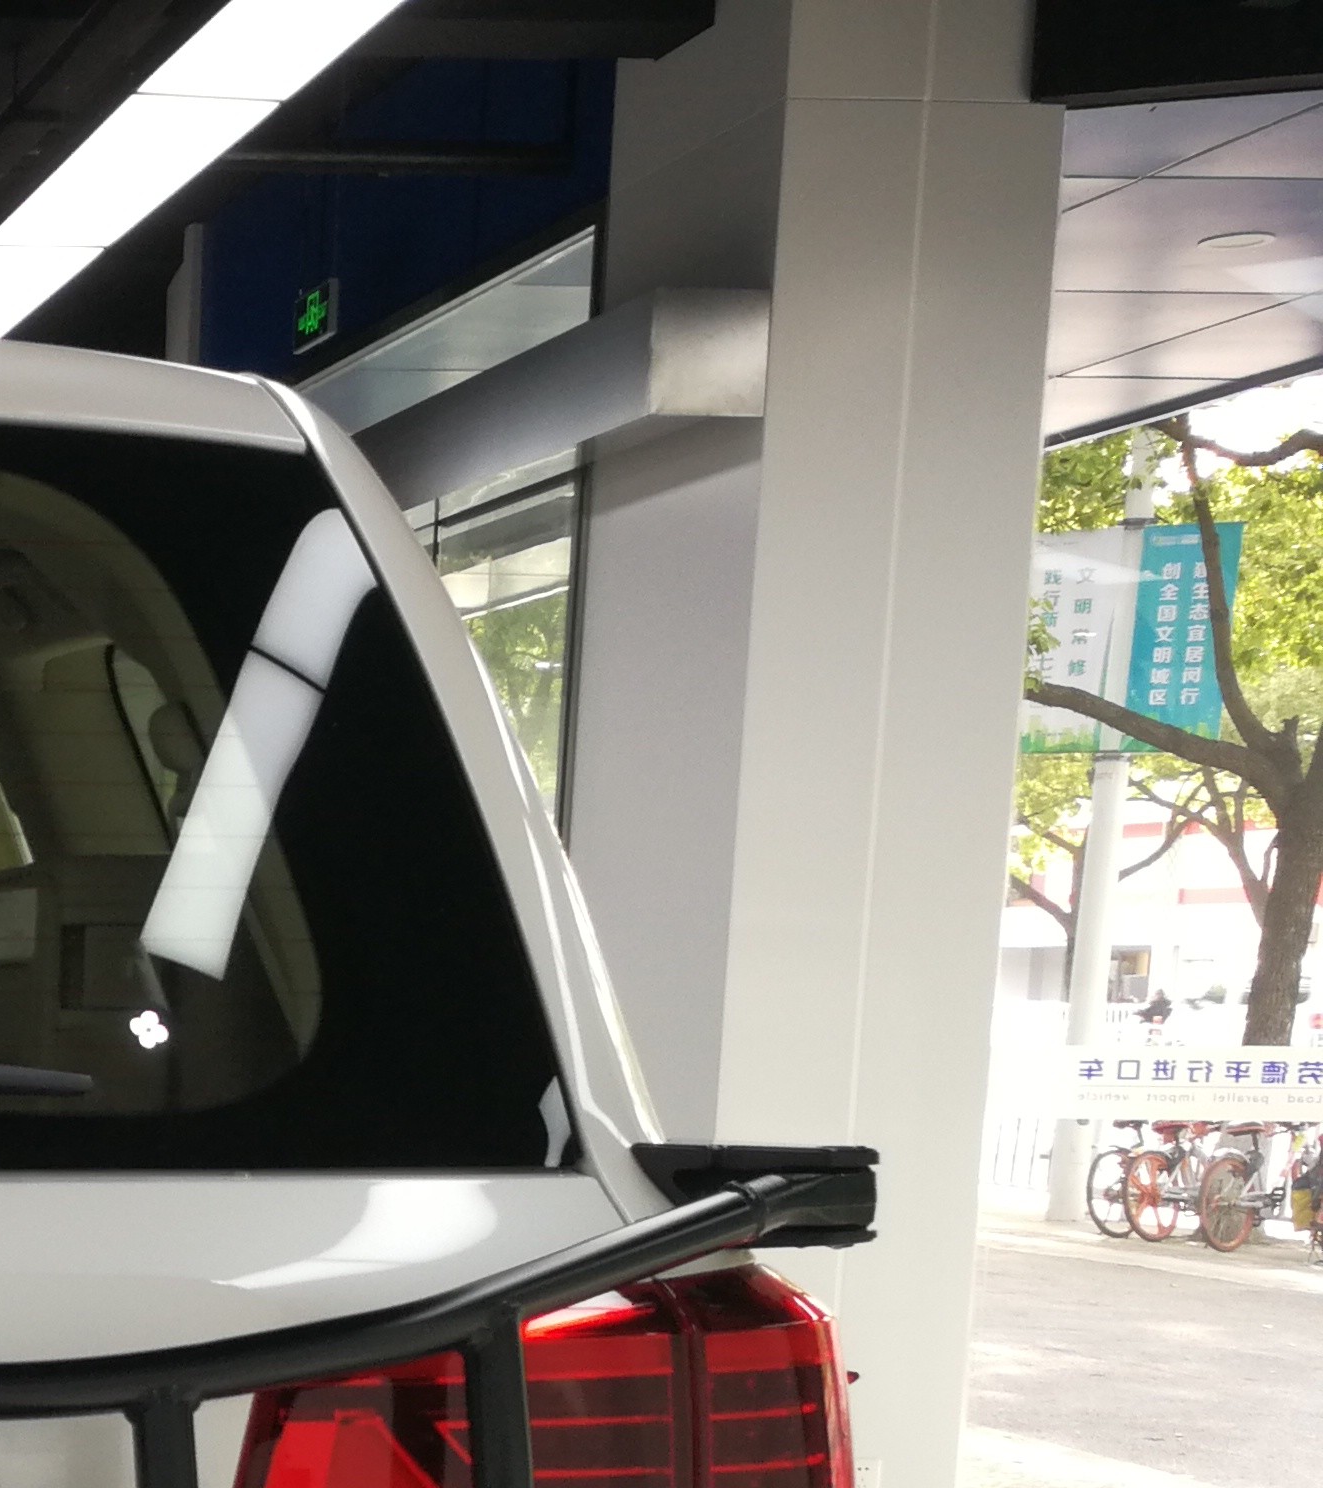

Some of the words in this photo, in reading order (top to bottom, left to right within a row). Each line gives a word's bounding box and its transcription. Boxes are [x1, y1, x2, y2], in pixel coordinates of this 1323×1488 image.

[1148, 562, 1182, 706] 创全国文明城区
